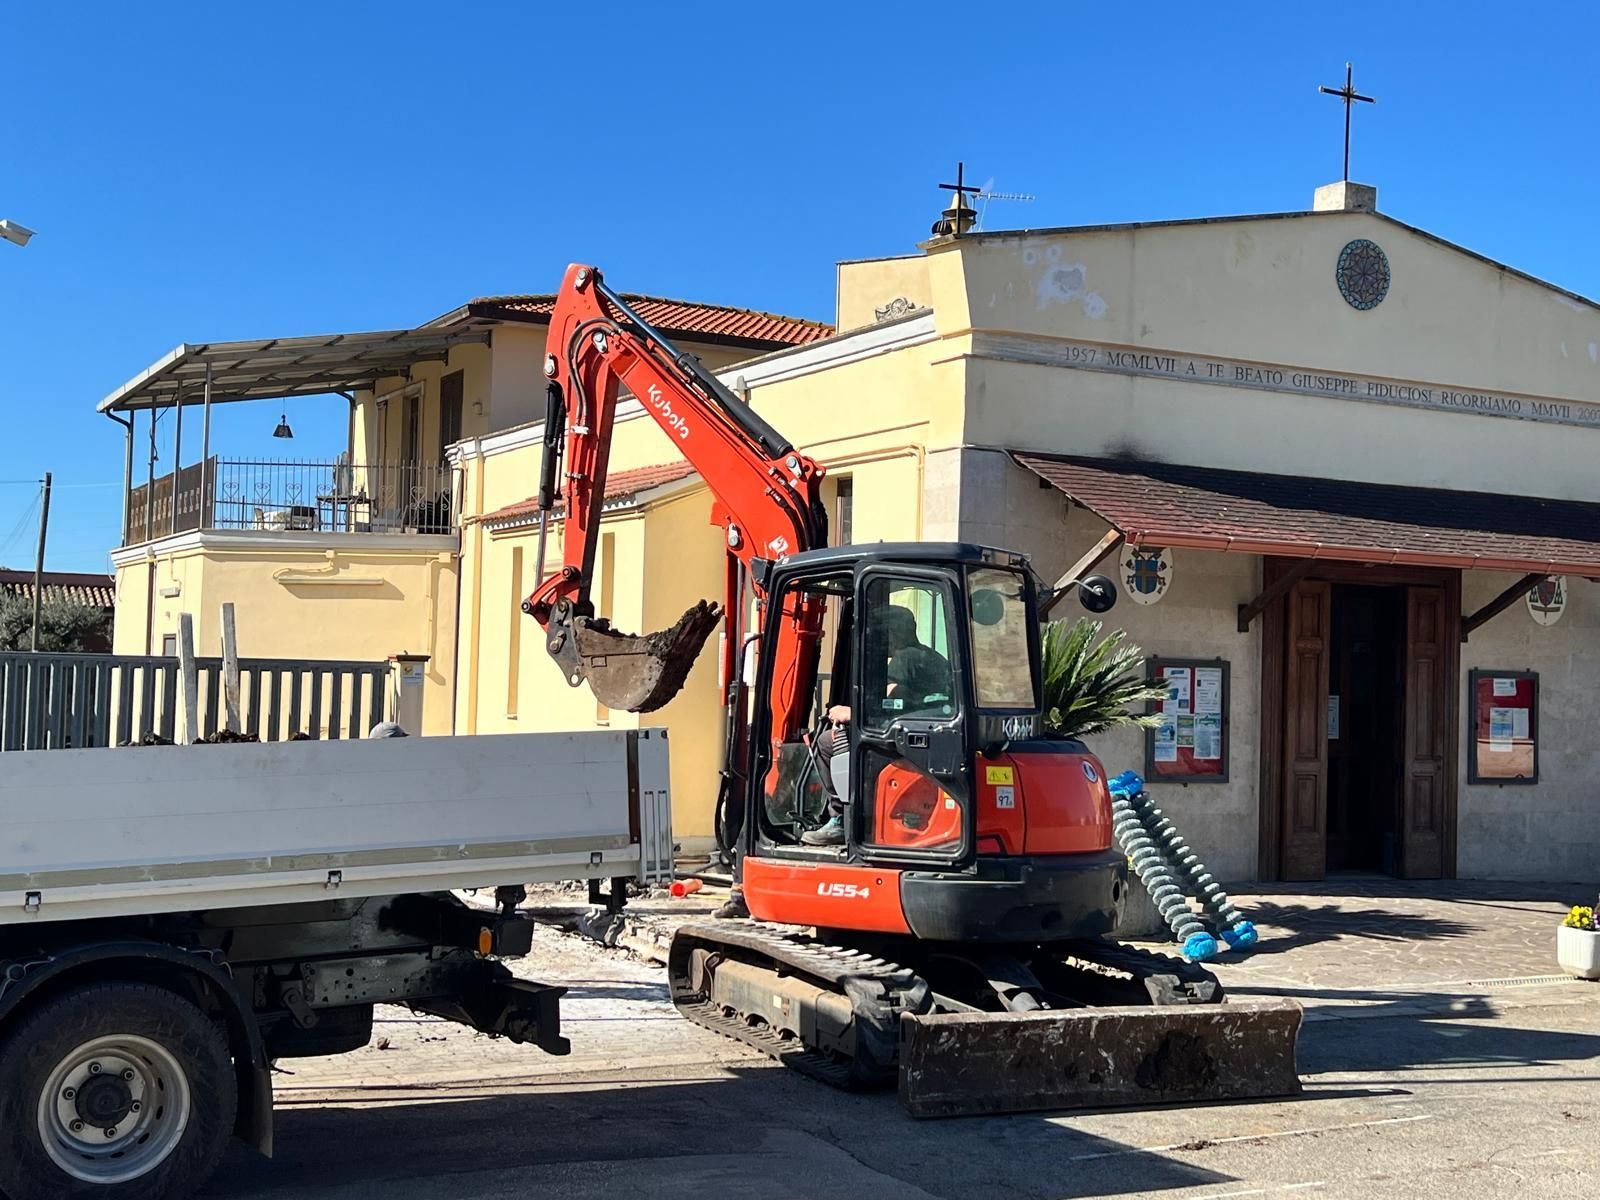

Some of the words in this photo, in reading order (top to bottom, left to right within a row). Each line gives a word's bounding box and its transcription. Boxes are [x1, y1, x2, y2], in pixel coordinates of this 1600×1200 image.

[648, 383, 690, 440] Kubota
[1065, 346, 1097, 363] 1957
[1106, 350, 1176, 373] MCMLVII
[1185, 361, 1197, 376] A
[1207, 363, 1225, 378] TE
[1292, 373, 1358, 394] GIUSEPPE
[1366, 382, 1433, 404] FIDUCIOSI
[1441, 391, 1521, 414] RICORRIAMO
[1531, 401, 1571, 418] MMVII
